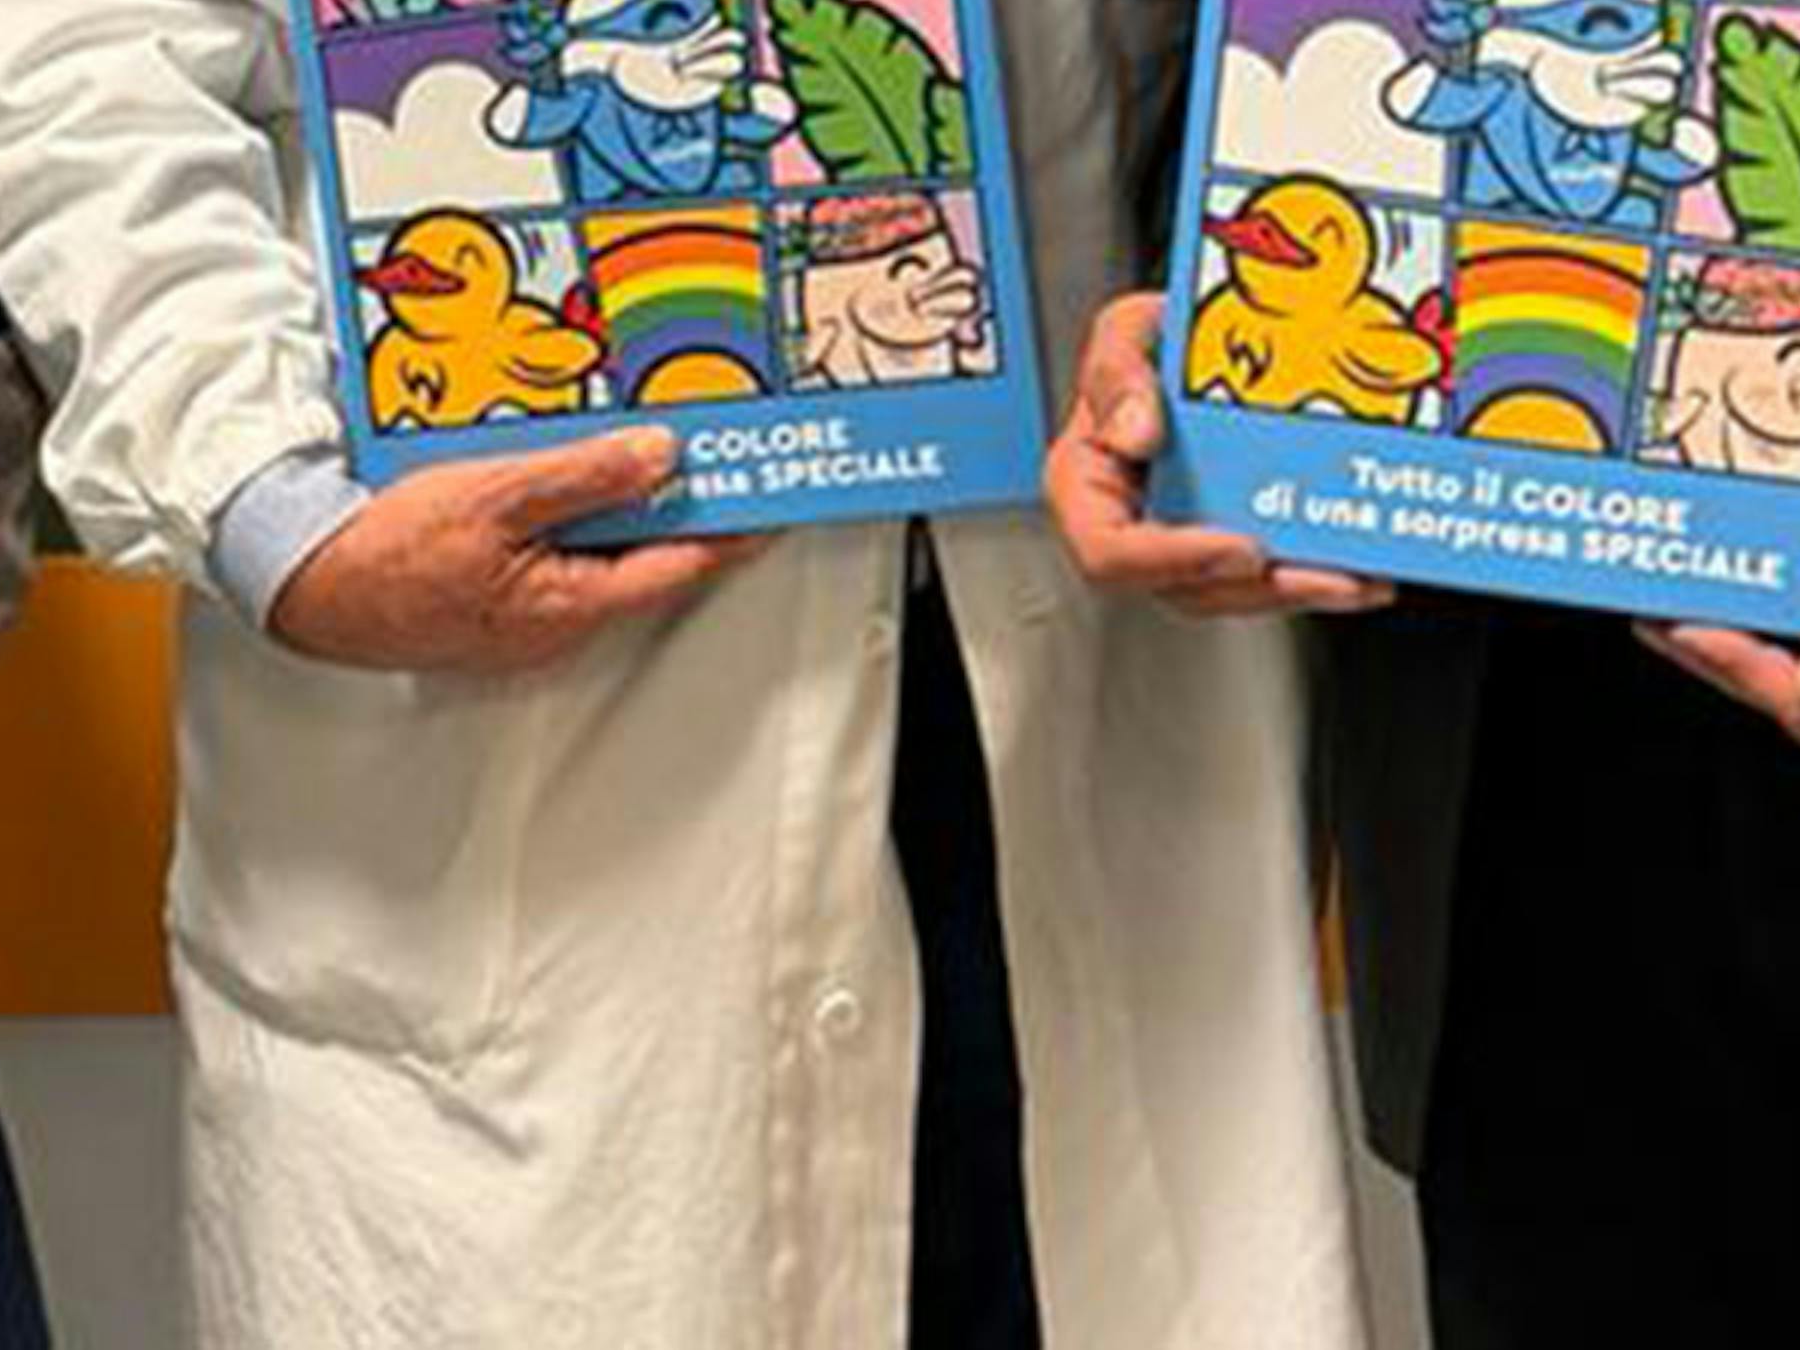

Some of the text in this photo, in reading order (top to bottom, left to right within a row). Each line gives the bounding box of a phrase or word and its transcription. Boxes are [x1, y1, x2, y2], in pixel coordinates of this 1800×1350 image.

[689, 419, 850, 463] COLORE
[761, 444, 944, 493] SPECIALE
[1351, 457, 1688, 534] Tutto il COLORE
[1251, 484, 1785, 589] di una sorpresa SPECIALE
